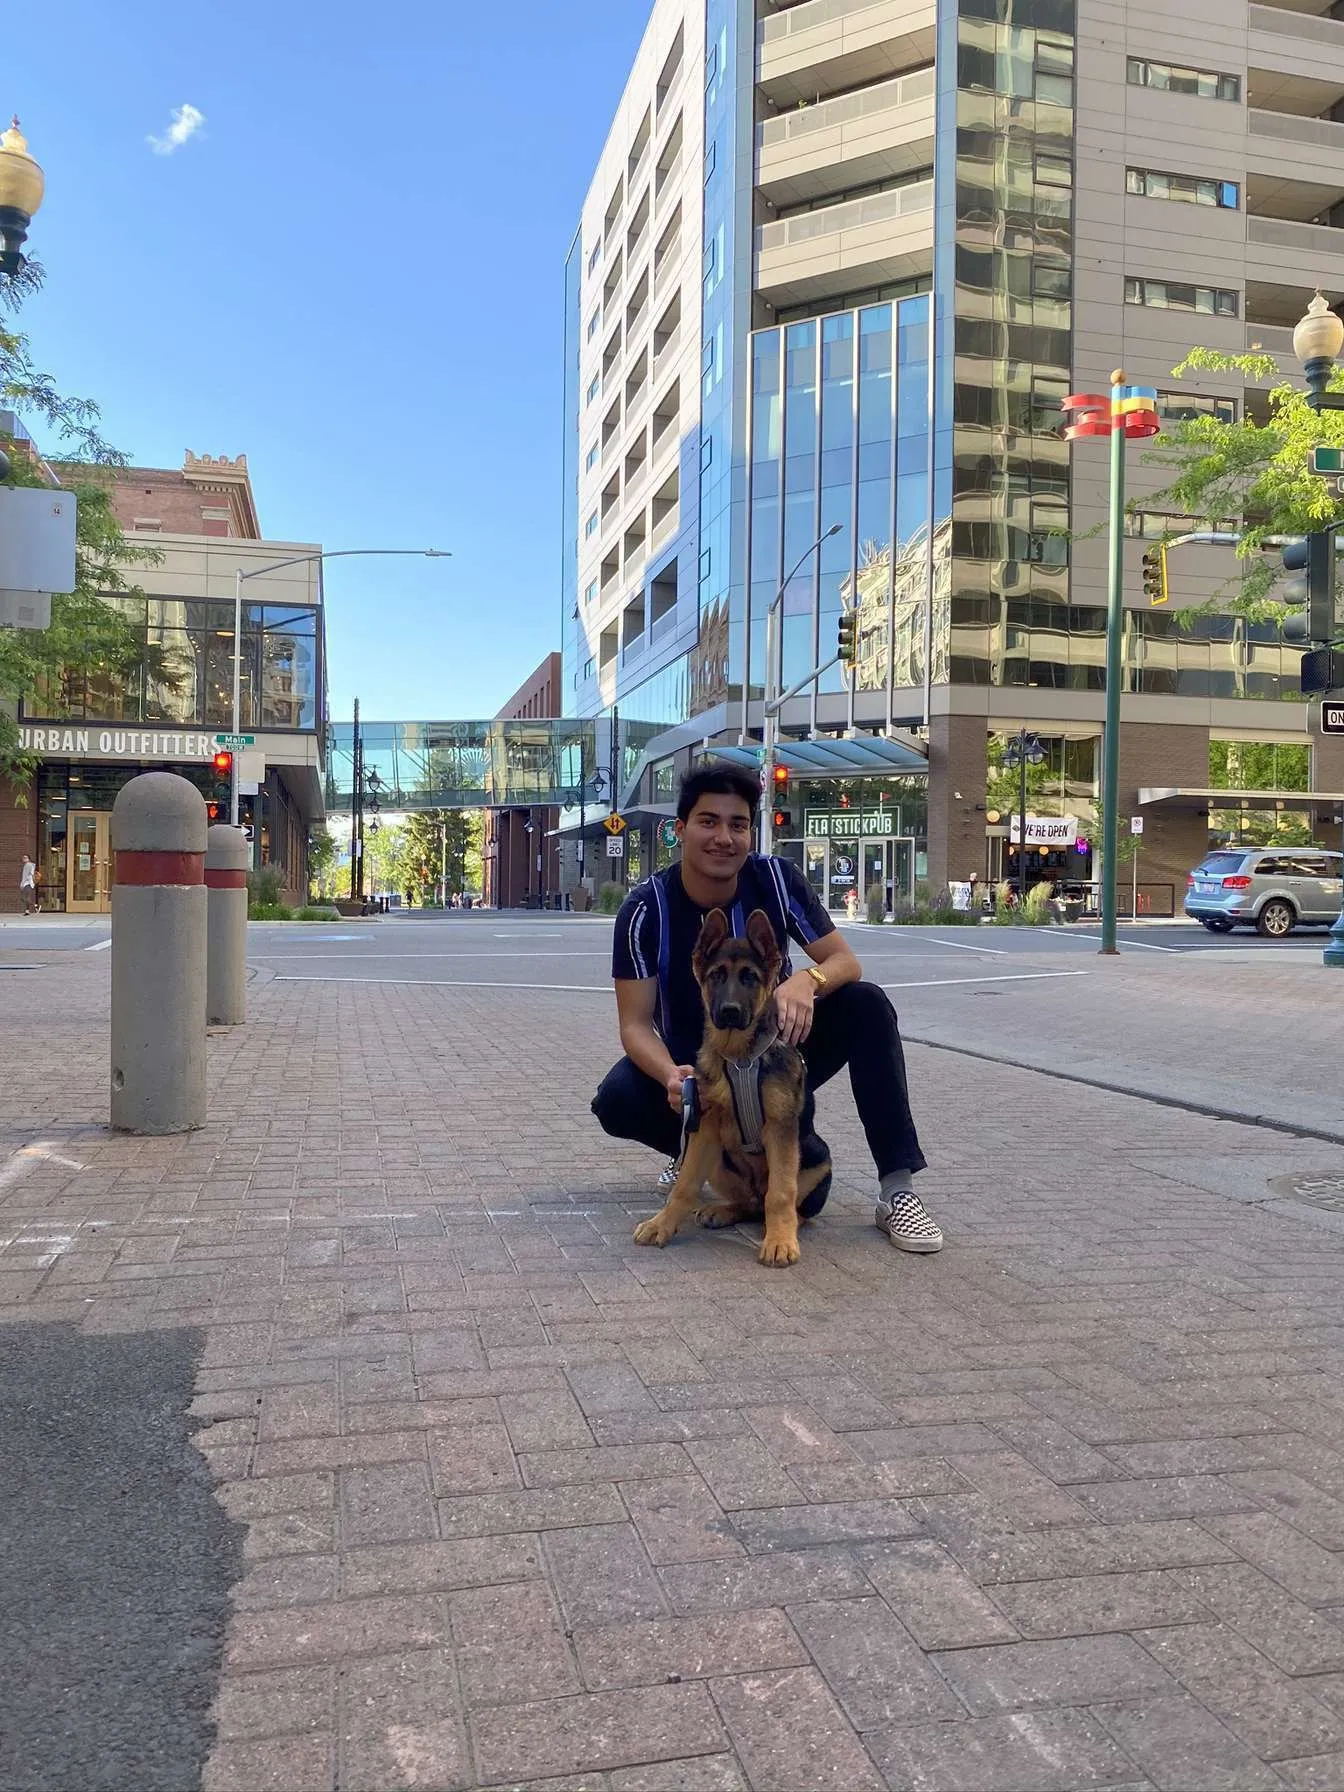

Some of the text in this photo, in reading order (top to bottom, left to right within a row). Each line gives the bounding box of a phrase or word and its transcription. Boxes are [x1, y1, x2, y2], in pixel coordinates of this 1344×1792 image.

[18, 728, 221, 756] URBAN OUTFITTERS
[225, 735, 246, 744] Main
[1047, 824, 1069, 838] OPEN
[608, 846, 622, 855] 20
